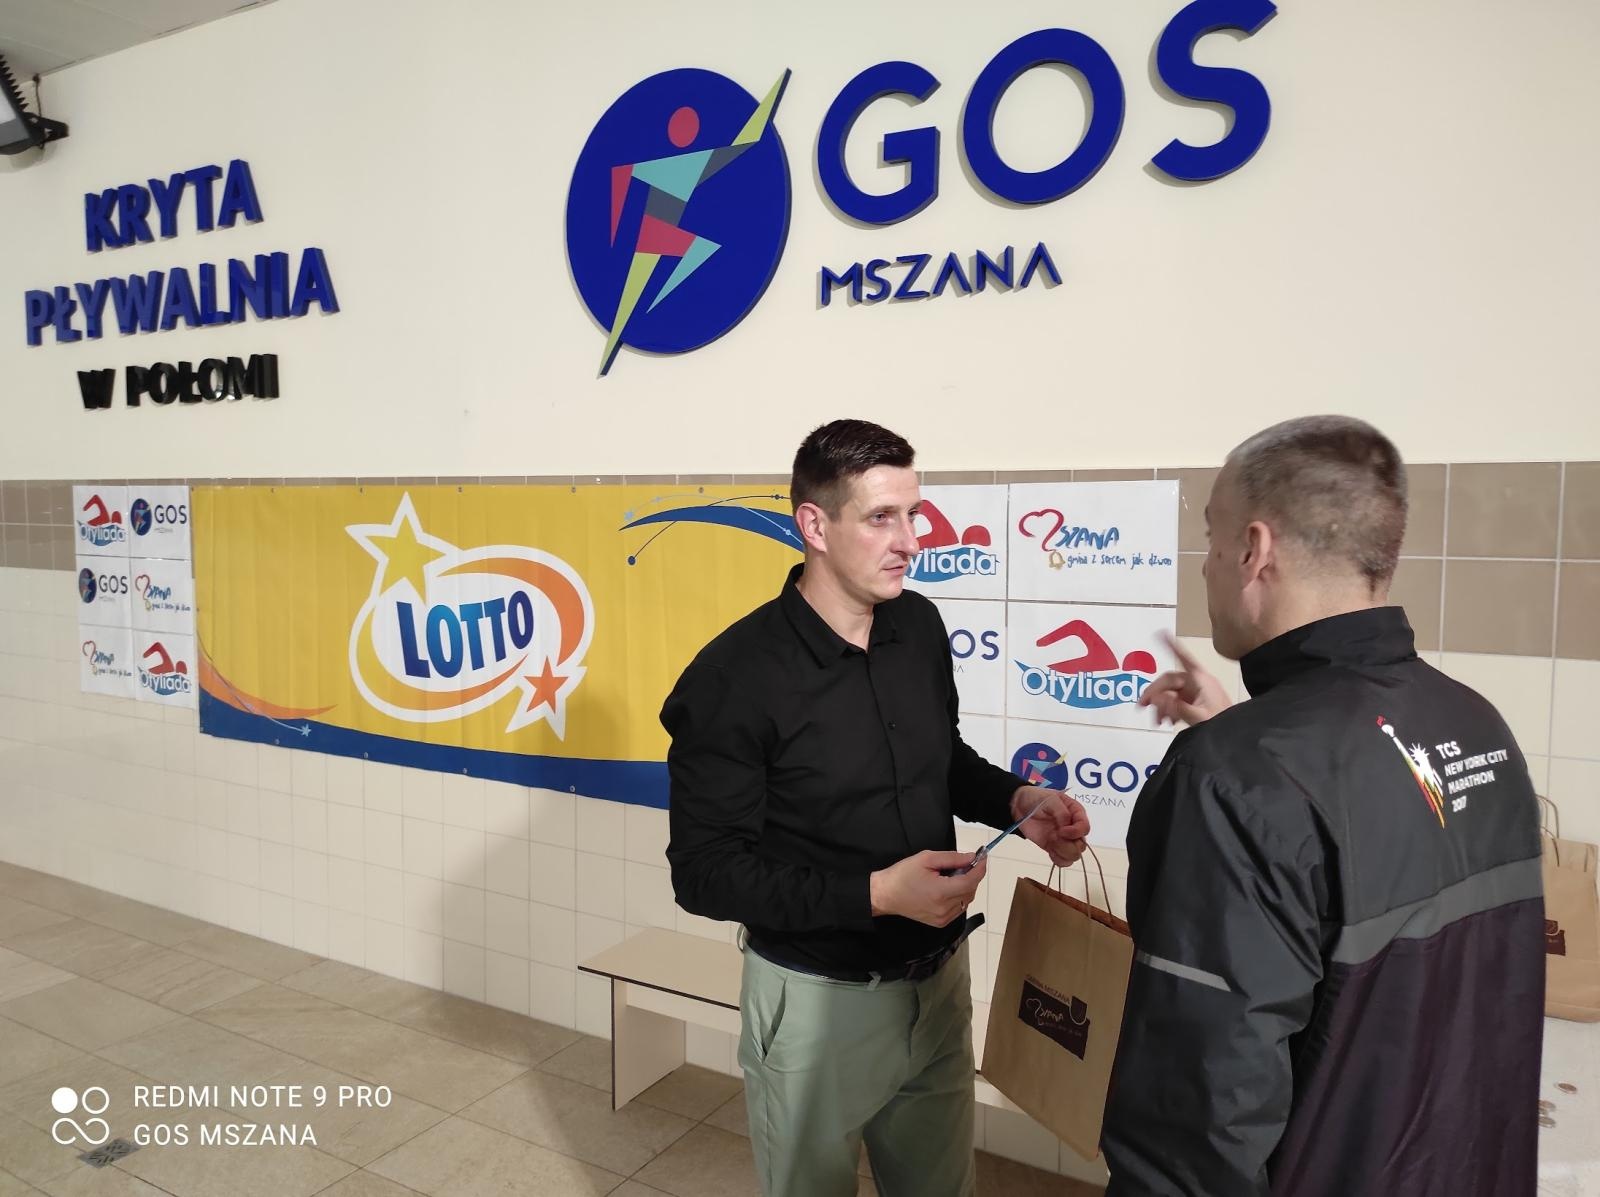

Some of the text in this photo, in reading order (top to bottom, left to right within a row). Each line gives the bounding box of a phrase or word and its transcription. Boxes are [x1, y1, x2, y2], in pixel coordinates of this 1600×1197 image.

[818, 0, 1278, 226] GOS
[85, 159, 264, 252] KRYTA
[821, 241, 1062, 306] MSZANA
[25, 248, 340, 346] PŁYWALNIA
[77, 353, 279, 409] W POŁOMI
[154, 505, 188, 525] GOS
[80, 524, 126, 542] Otyliada
[908, 548, 997, 579] yliada
[1131, 553, 1145, 570] jak
[99, 574, 129, 595] GOS
[396, 590, 534, 678] LOTTO
[948, 629, 1000, 661] OS
[140, 671, 192, 697] Otyliada
[1435, 741, 1462, 759] TCS
[1444, 749, 1508, 776] NEW YORK CITY
[1447, 770, 1496, 795] MARATHON
[1074, 794, 1126, 808] MSZANA
